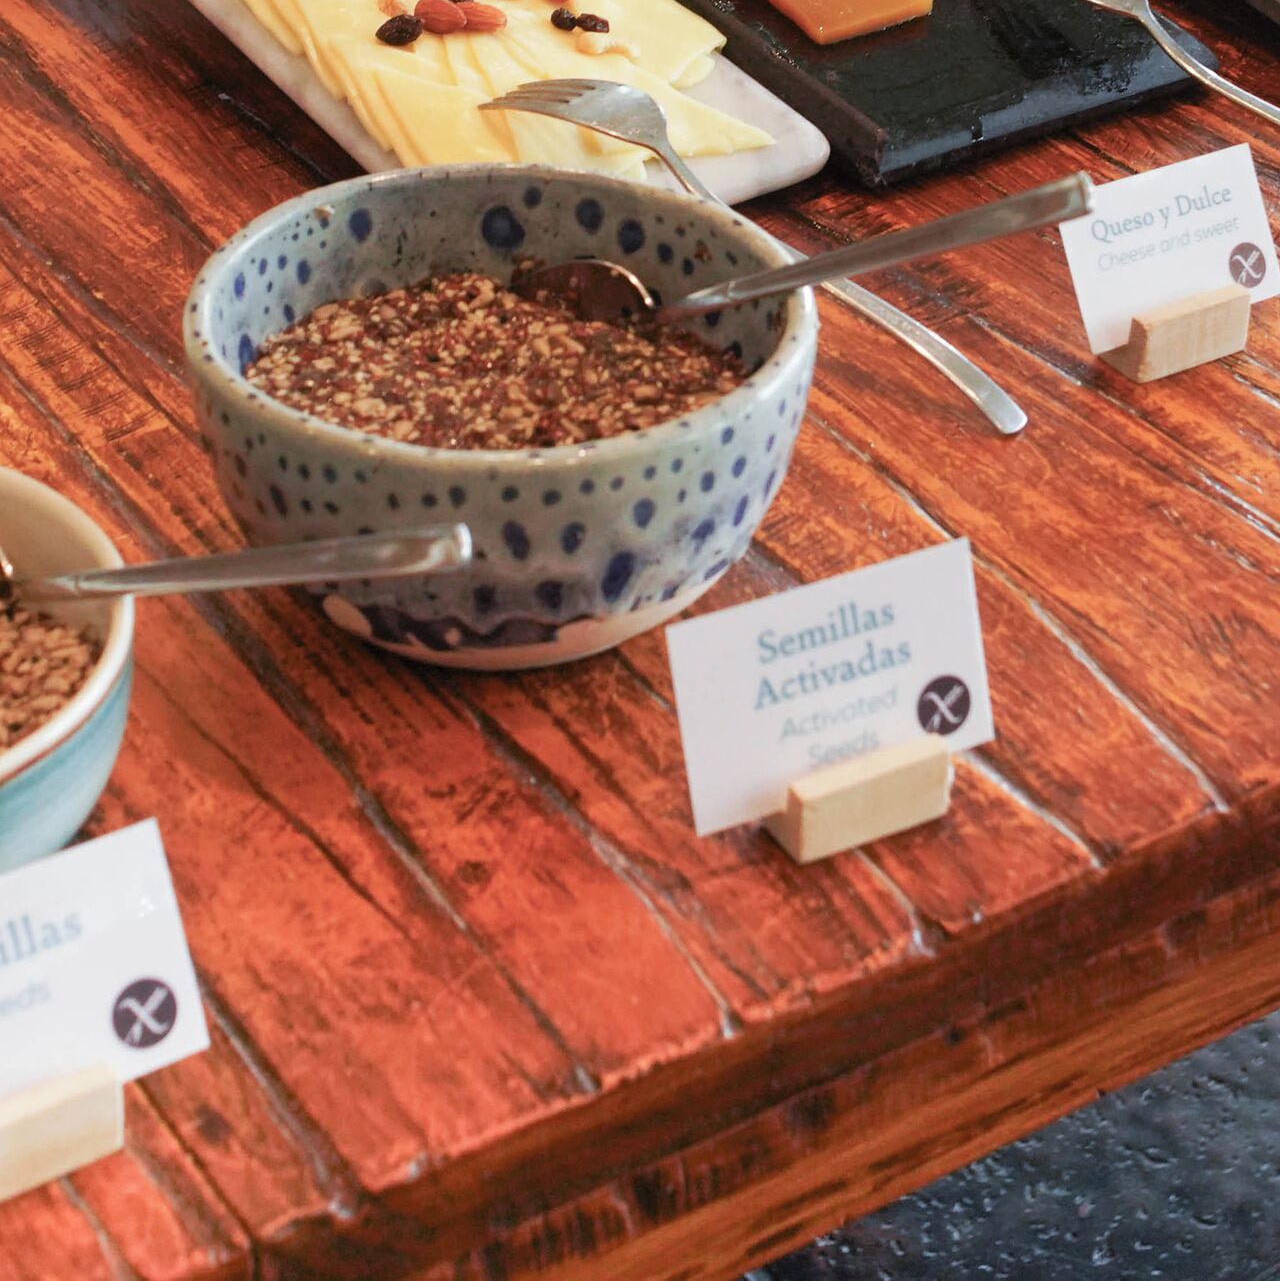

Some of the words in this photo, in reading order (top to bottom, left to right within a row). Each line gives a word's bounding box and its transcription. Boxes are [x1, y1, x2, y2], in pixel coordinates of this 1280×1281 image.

[1091, 211, 1154, 244] Queso
[1158, 206, 1170, 230] y
[1174, 186, 1233, 216] Dulce
[1098, 242, 1156, 271] Cheese
[1160, 230, 1191, 253] and
[1194, 216, 1240, 242] sweet
[756, 601, 895, 665] Semillas
[753, 640, 913, 710] Activadas
[780, 684, 898, 739] Activated
[808, 728, 880, 768] Seeds
